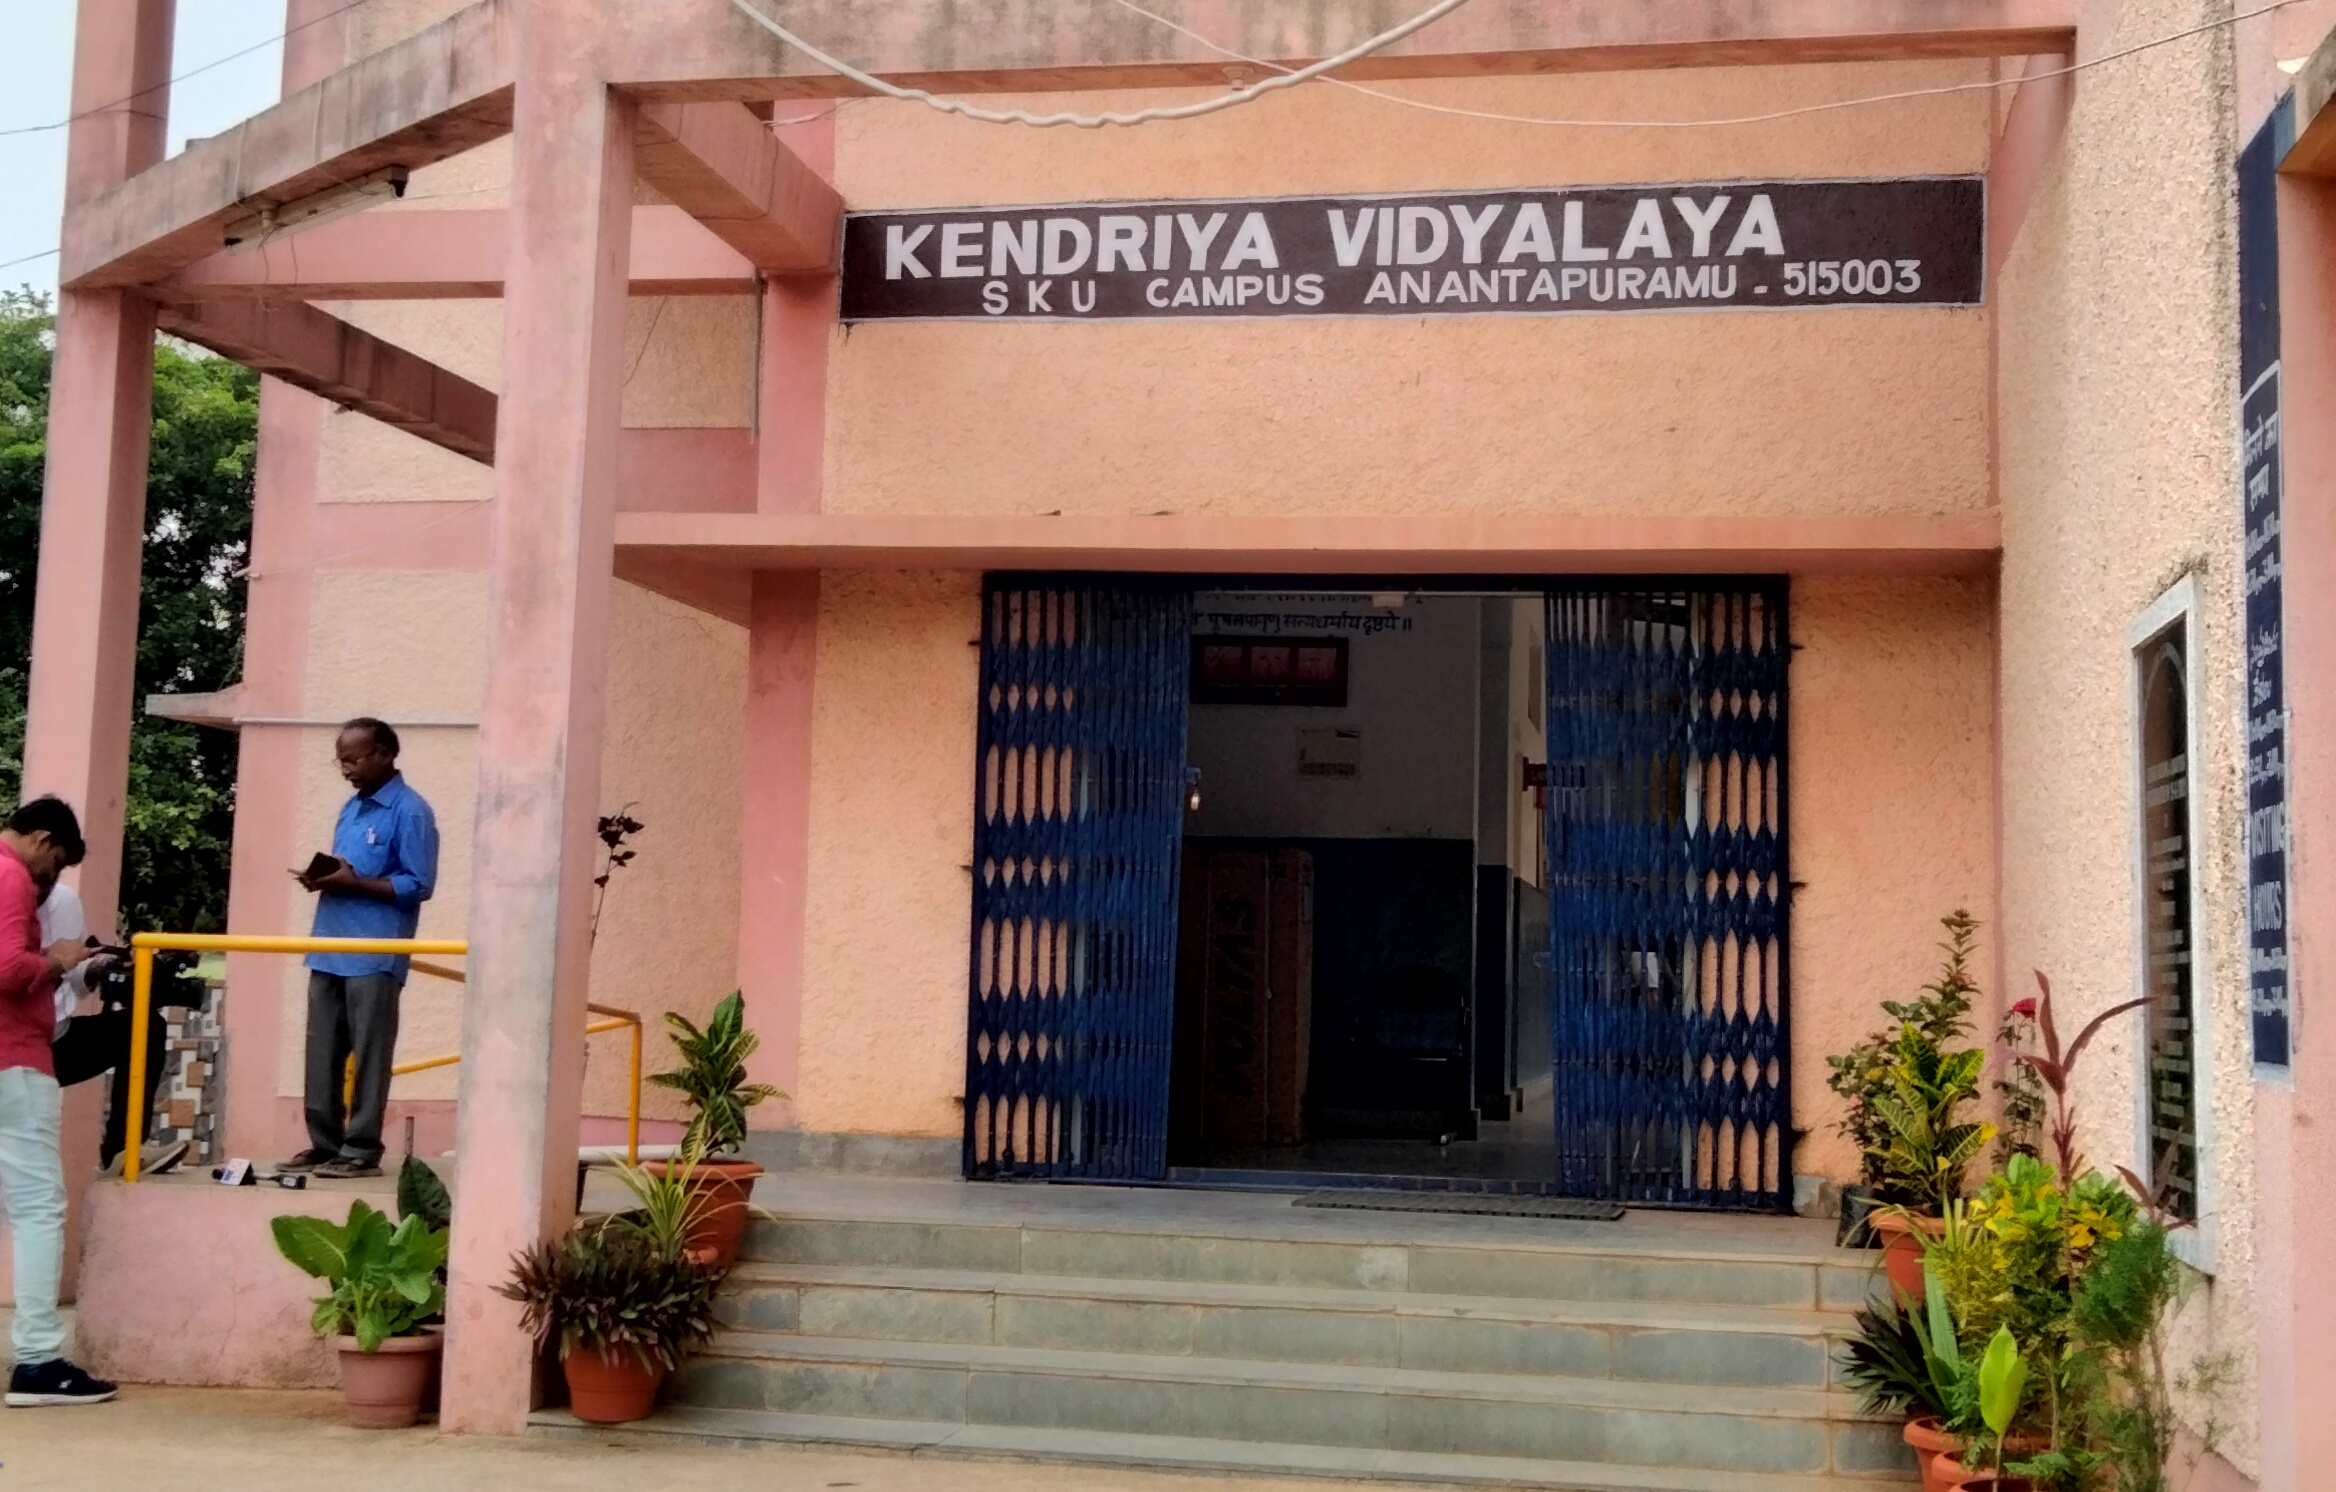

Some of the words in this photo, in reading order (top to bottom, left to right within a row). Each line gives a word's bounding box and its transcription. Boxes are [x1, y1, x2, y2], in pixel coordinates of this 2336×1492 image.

[885, 211, 1280, 280] KENDRIYA
[1327, 194, 1785, 268] VIDYALAYA
[1146, 273, 1325, 308] CAMPUS
[1364, 264, 1738, 304] ANANTAPURAMU
[1782, 258, 1922, 297] 515003
[2253, 880, 2283, 932] HOURS
